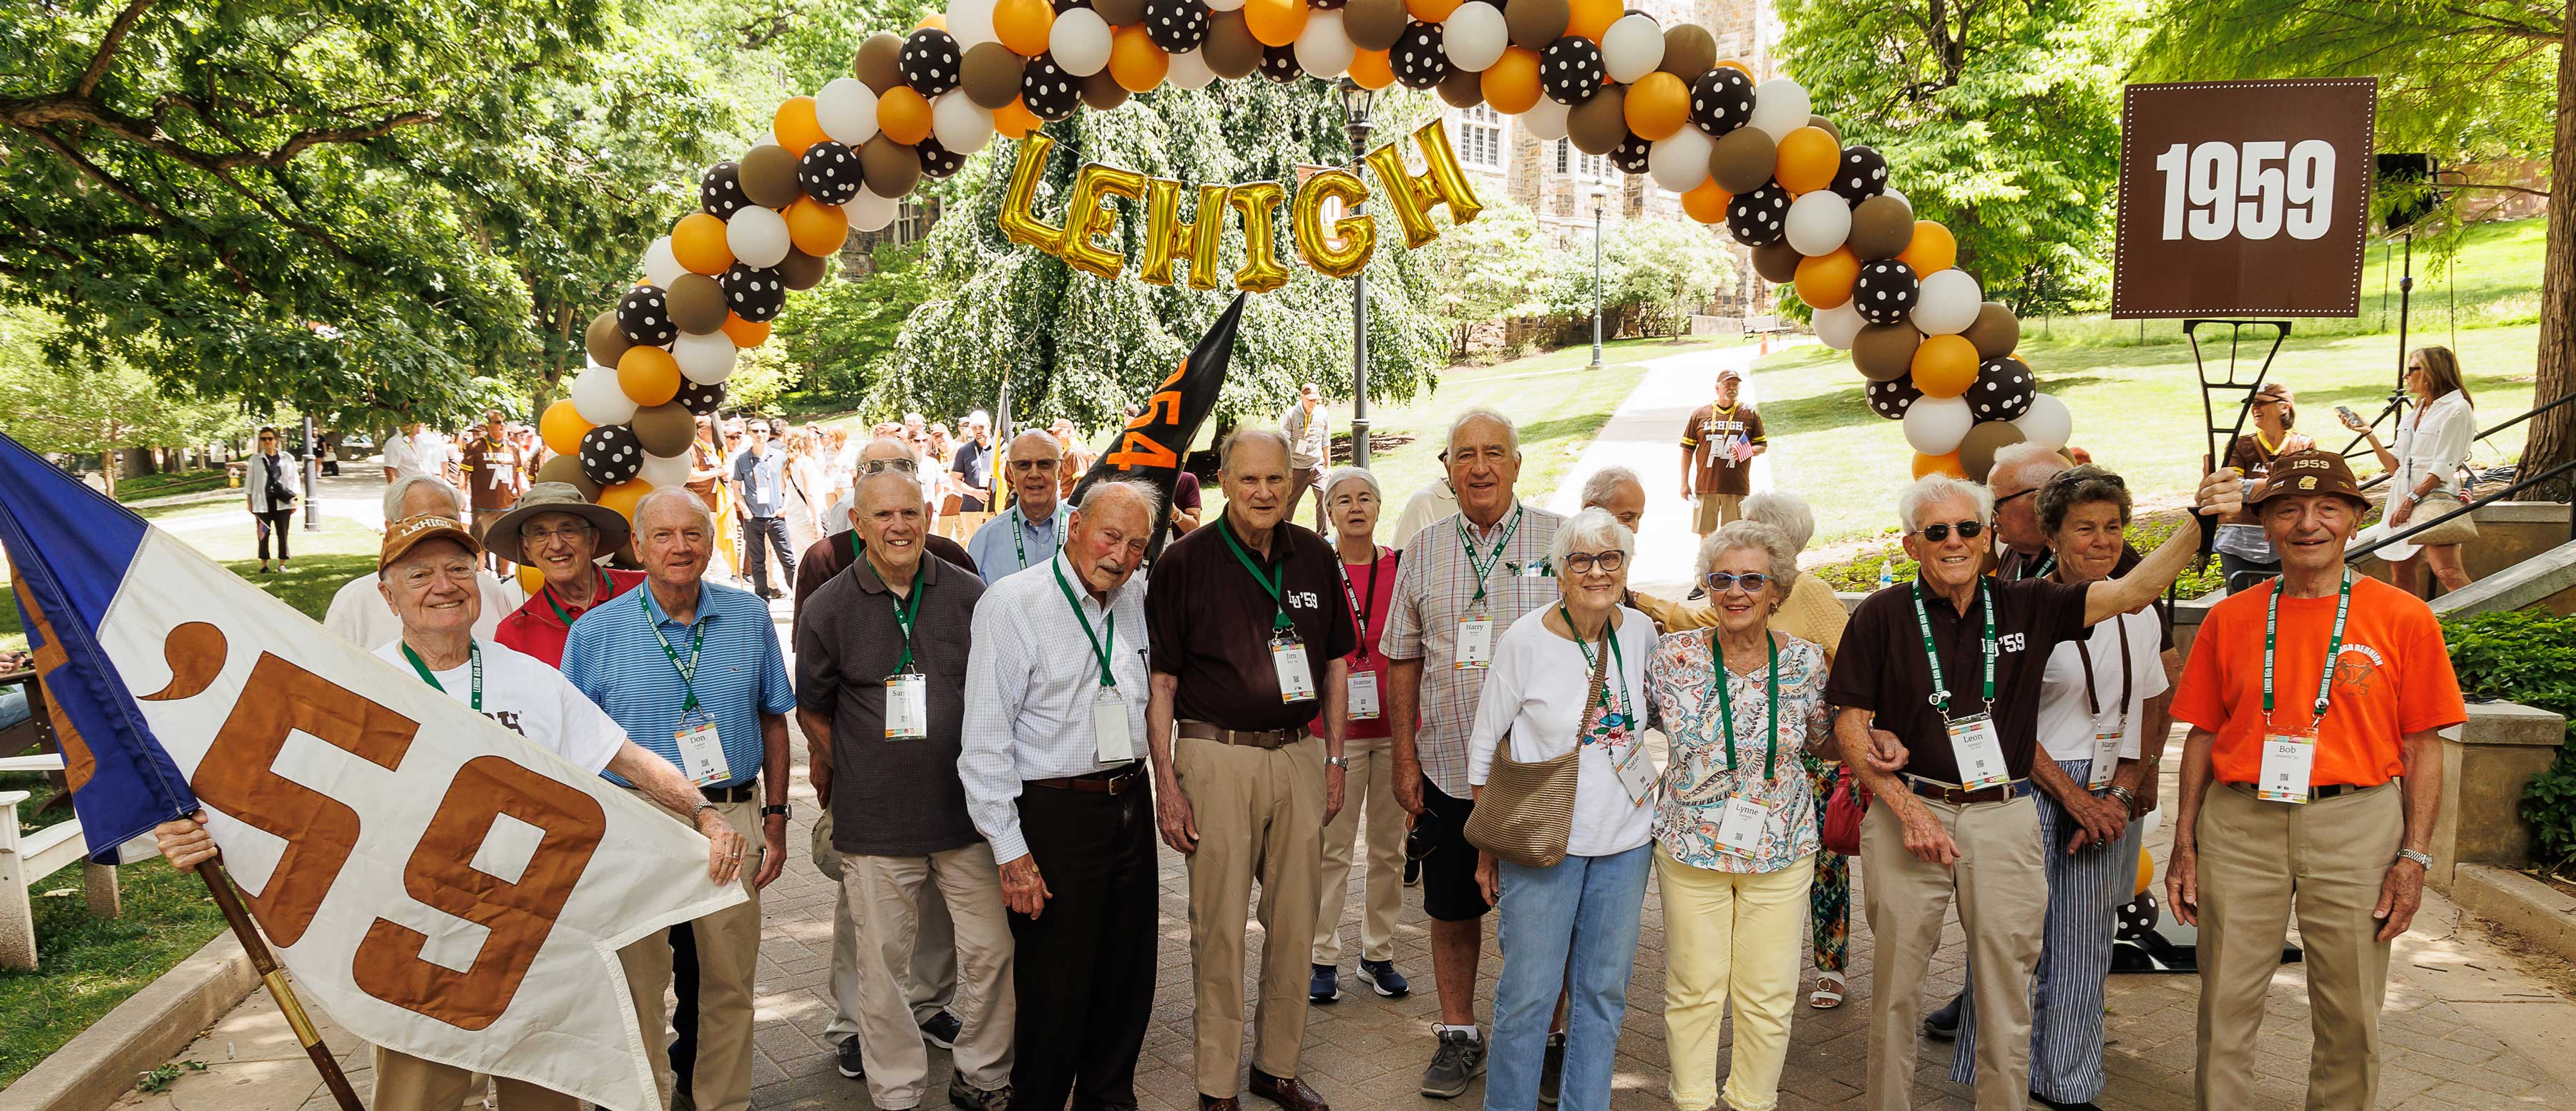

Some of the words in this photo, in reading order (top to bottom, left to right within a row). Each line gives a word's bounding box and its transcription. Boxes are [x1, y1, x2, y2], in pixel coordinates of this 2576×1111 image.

[2156, 140, 2336, 241] 1959
[998, 117, 1483, 293] LEHIGH
[2292, 459, 2331, 470] 1959
[401, 519, 452, 537] LEHIGH
[2269, 593, 2278, 610] REUNION
[2340, 594, 2349, 607] LEHIGH
[2267, 620, 2275, 635] LEHIGH
[2333, 618, 2346, 637] REUNION
[472, 649, 481, 667] REUNION
[1582, 644, 1593, 657] LEHIGH
[2265, 649, 2273, 667] REUNION
[2354, 644, 2384, 666] REUNION
[2326, 652, 2336, 667] LEHIGH
[2264, 677, 2273, 692] LEHIGH
[2319, 678, 2331, 698] REUNION
[690, 735, 706, 744] Don
[1963, 733, 1984, 743] Leon
[1626, 755, 1639, 771] Katie
[1735, 804, 1759, 816] Lynne
